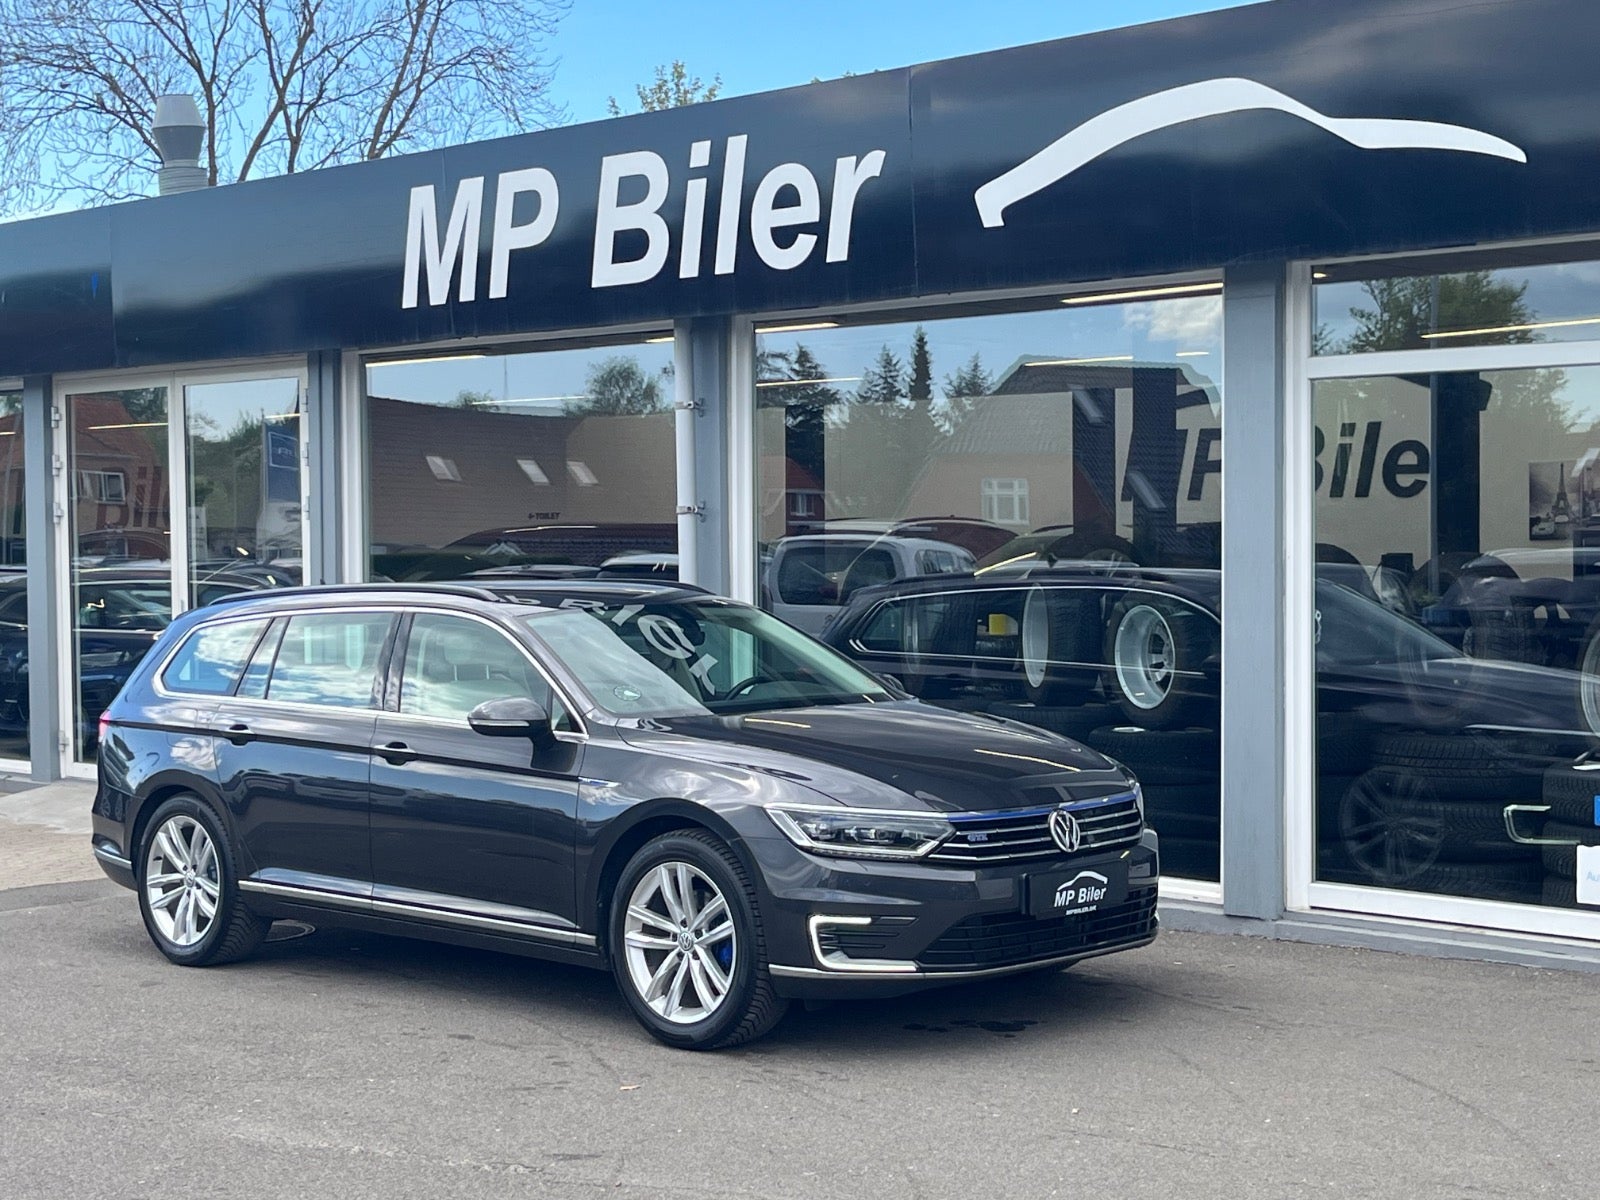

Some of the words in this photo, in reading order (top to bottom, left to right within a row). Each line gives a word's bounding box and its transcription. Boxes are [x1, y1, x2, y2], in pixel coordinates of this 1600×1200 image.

[402, 167, 559, 309] MP
[591, 134, 886, 289] Biler
[1054, 890, 1075, 907] MP
[1077, 886, 1107, 904] Biler
